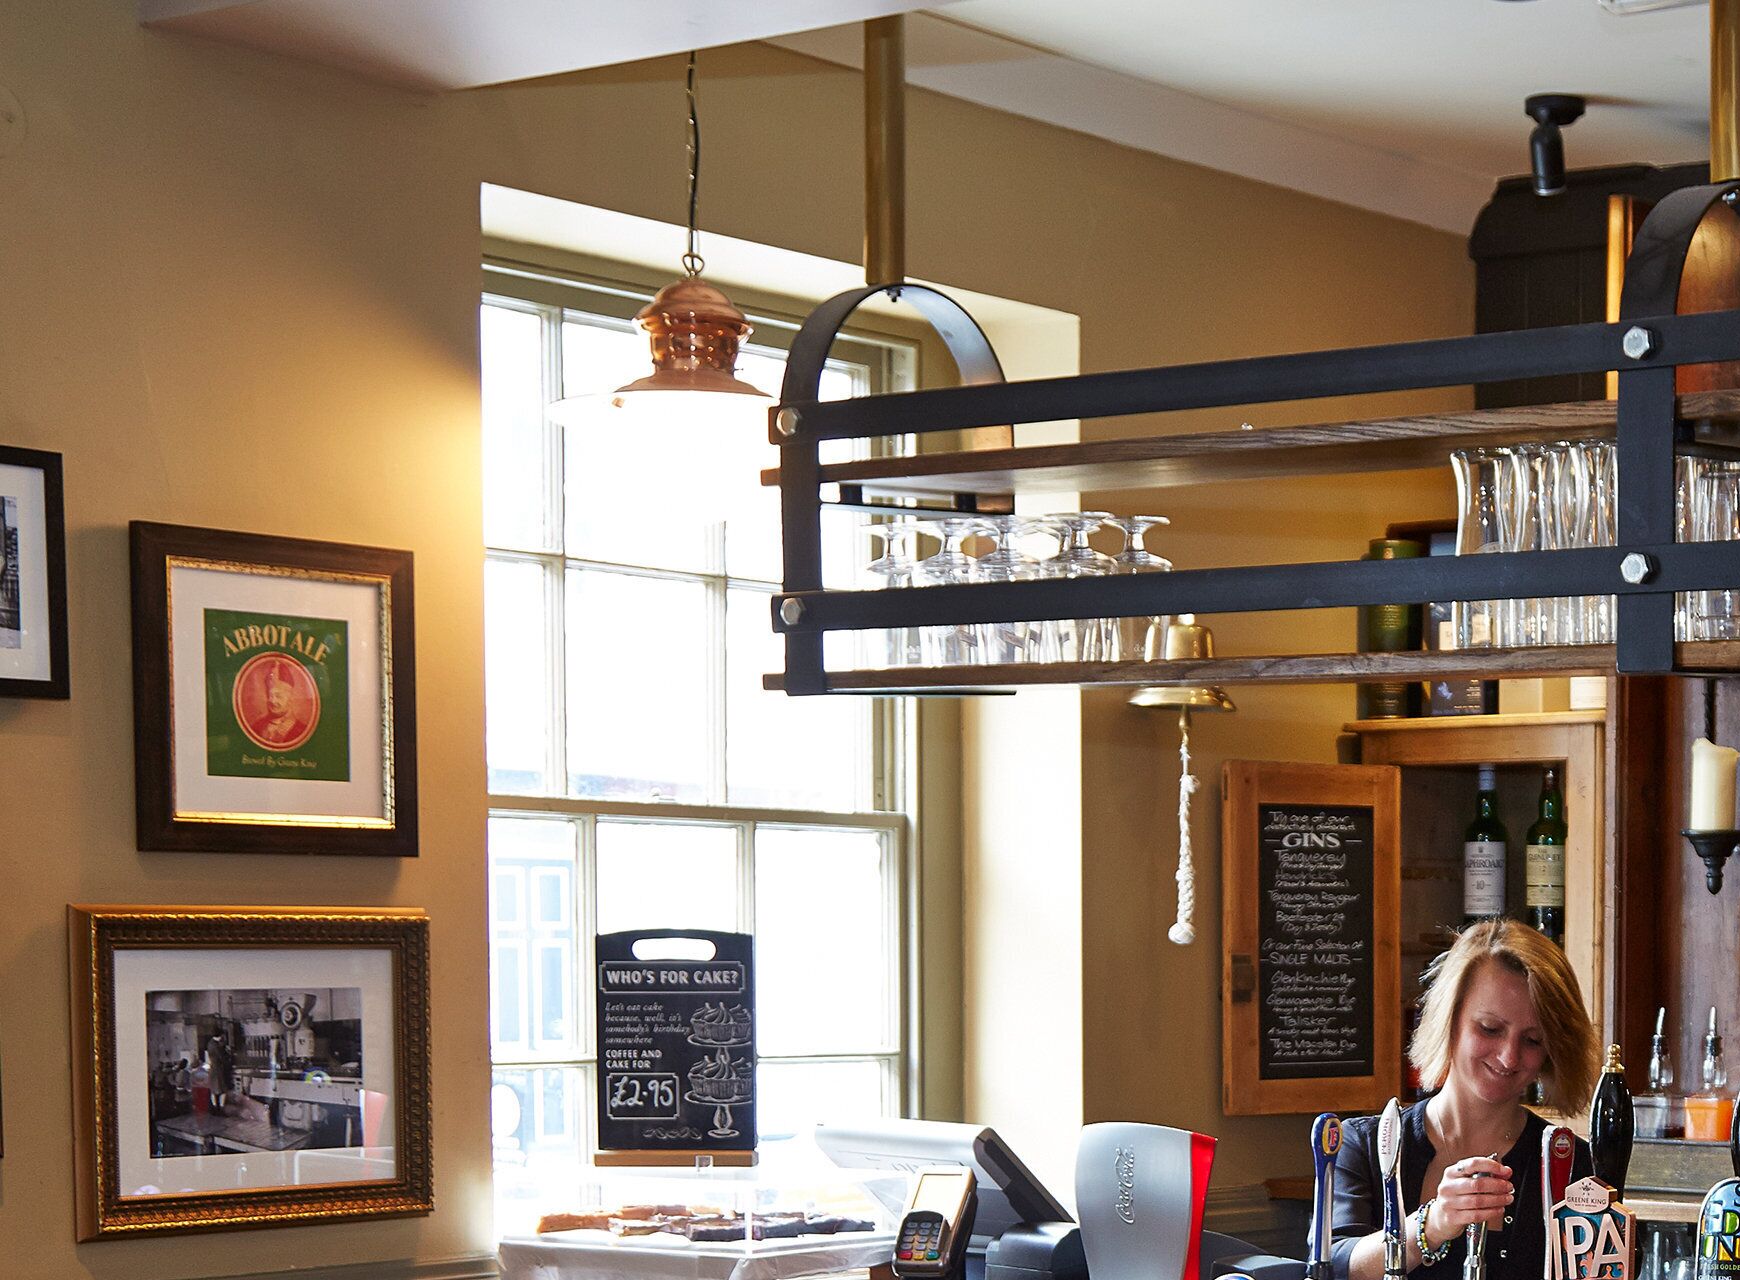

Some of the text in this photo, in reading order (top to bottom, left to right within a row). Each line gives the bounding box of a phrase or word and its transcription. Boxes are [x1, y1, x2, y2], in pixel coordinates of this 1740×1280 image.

[223, 624, 330, 665] ABBOT ALE
[1281, 832, 1340, 847] GINS
[1273, 849, 1346, 863] Tanqueray
[1269, 951, 1351, 965] SINGLE MALTS
[606, 969, 739, 984] WHO'S FOR CAKE?
[643, 1002, 664, 1011] cake
[1279, 1016, 1337, 1027] Talisker
[605, 1024, 690, 1035] somebody's birthday
[605, 1035, 653, 1044] somewhere
[606, 1049, 662, 1058] COFFEE AND
[606, 1060, 651, 1068] CAKE FOR
[1114, 1145, 1135, 1224] Coca-Cola
[1552, 1213, 1628, 1280] IPA
